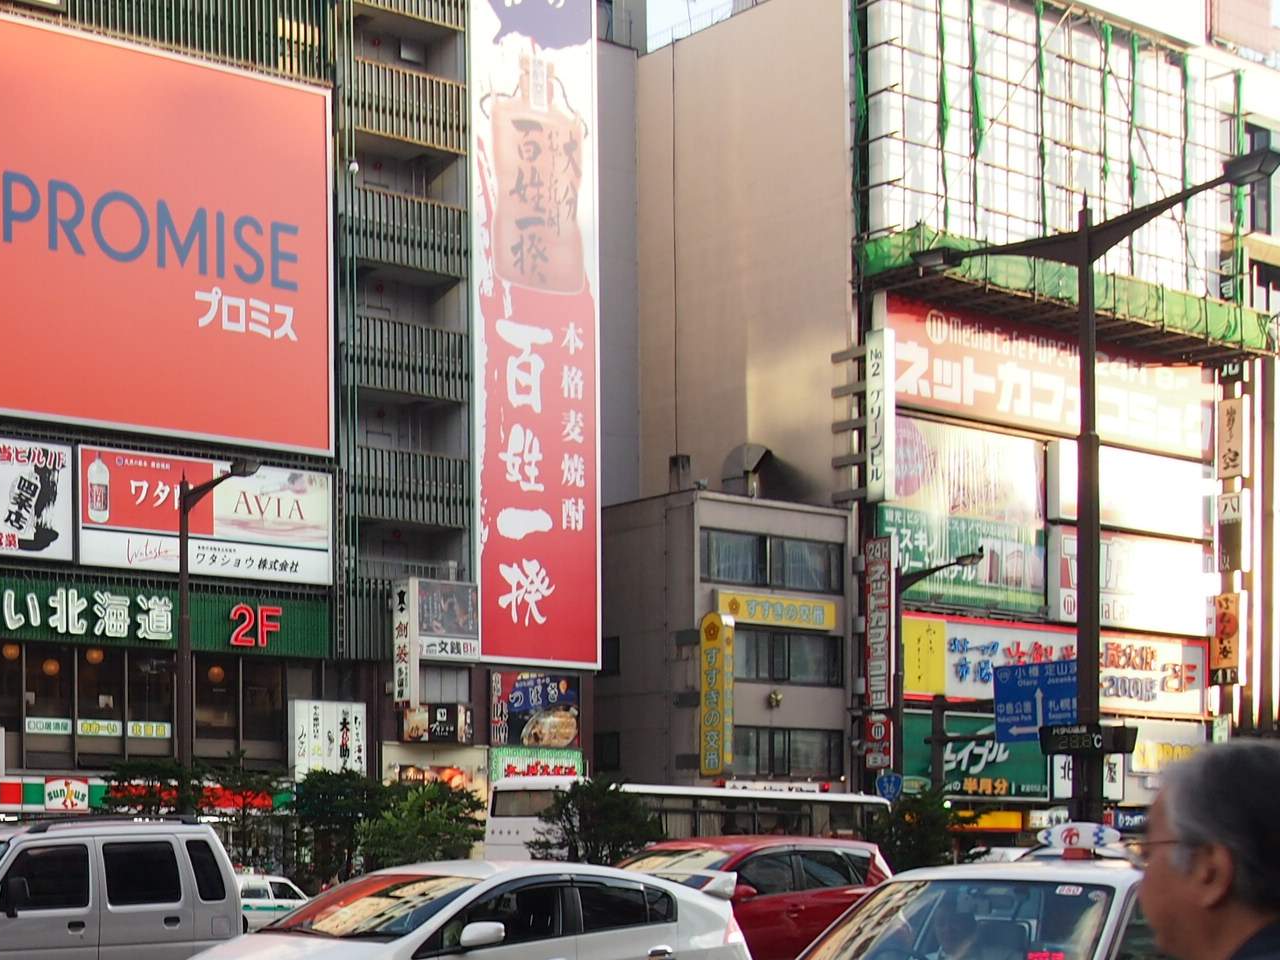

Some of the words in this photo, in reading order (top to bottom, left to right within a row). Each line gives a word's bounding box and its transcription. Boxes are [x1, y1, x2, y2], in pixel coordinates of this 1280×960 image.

[1, 170, 299, 292] PROMISE
[195, 286, 298, 342] プロミス
[495, 319, 555, 627] 百姓一揆
[561, 322, 585, 531] 本格麦焼酎
[229, 602, 283, 648] 2F
